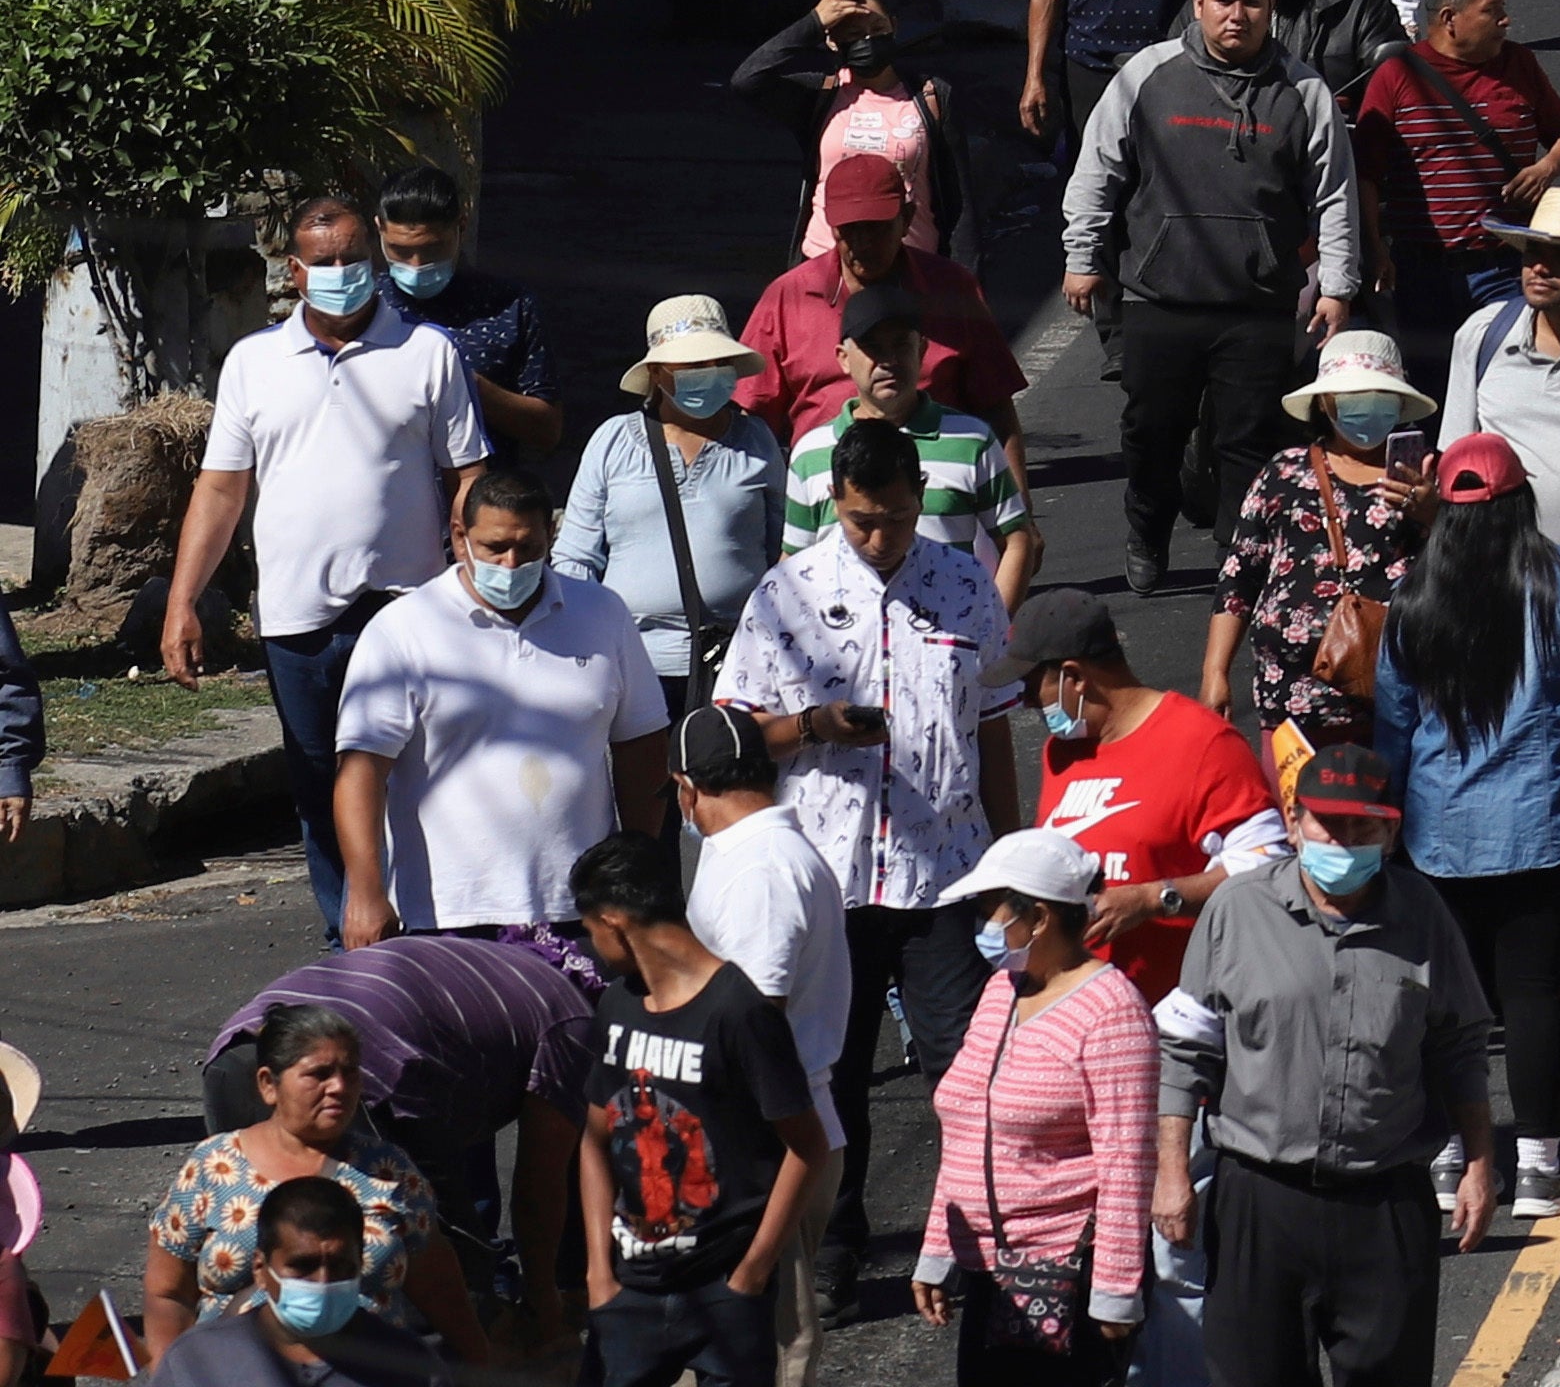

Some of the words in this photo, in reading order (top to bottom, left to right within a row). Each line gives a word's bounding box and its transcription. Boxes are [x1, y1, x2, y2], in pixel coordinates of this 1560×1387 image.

[1055, 777, 1122, 820] NIKE
[604, 1024, 620, 1067] I
[625, 1032, 704, 1085] HAVE
